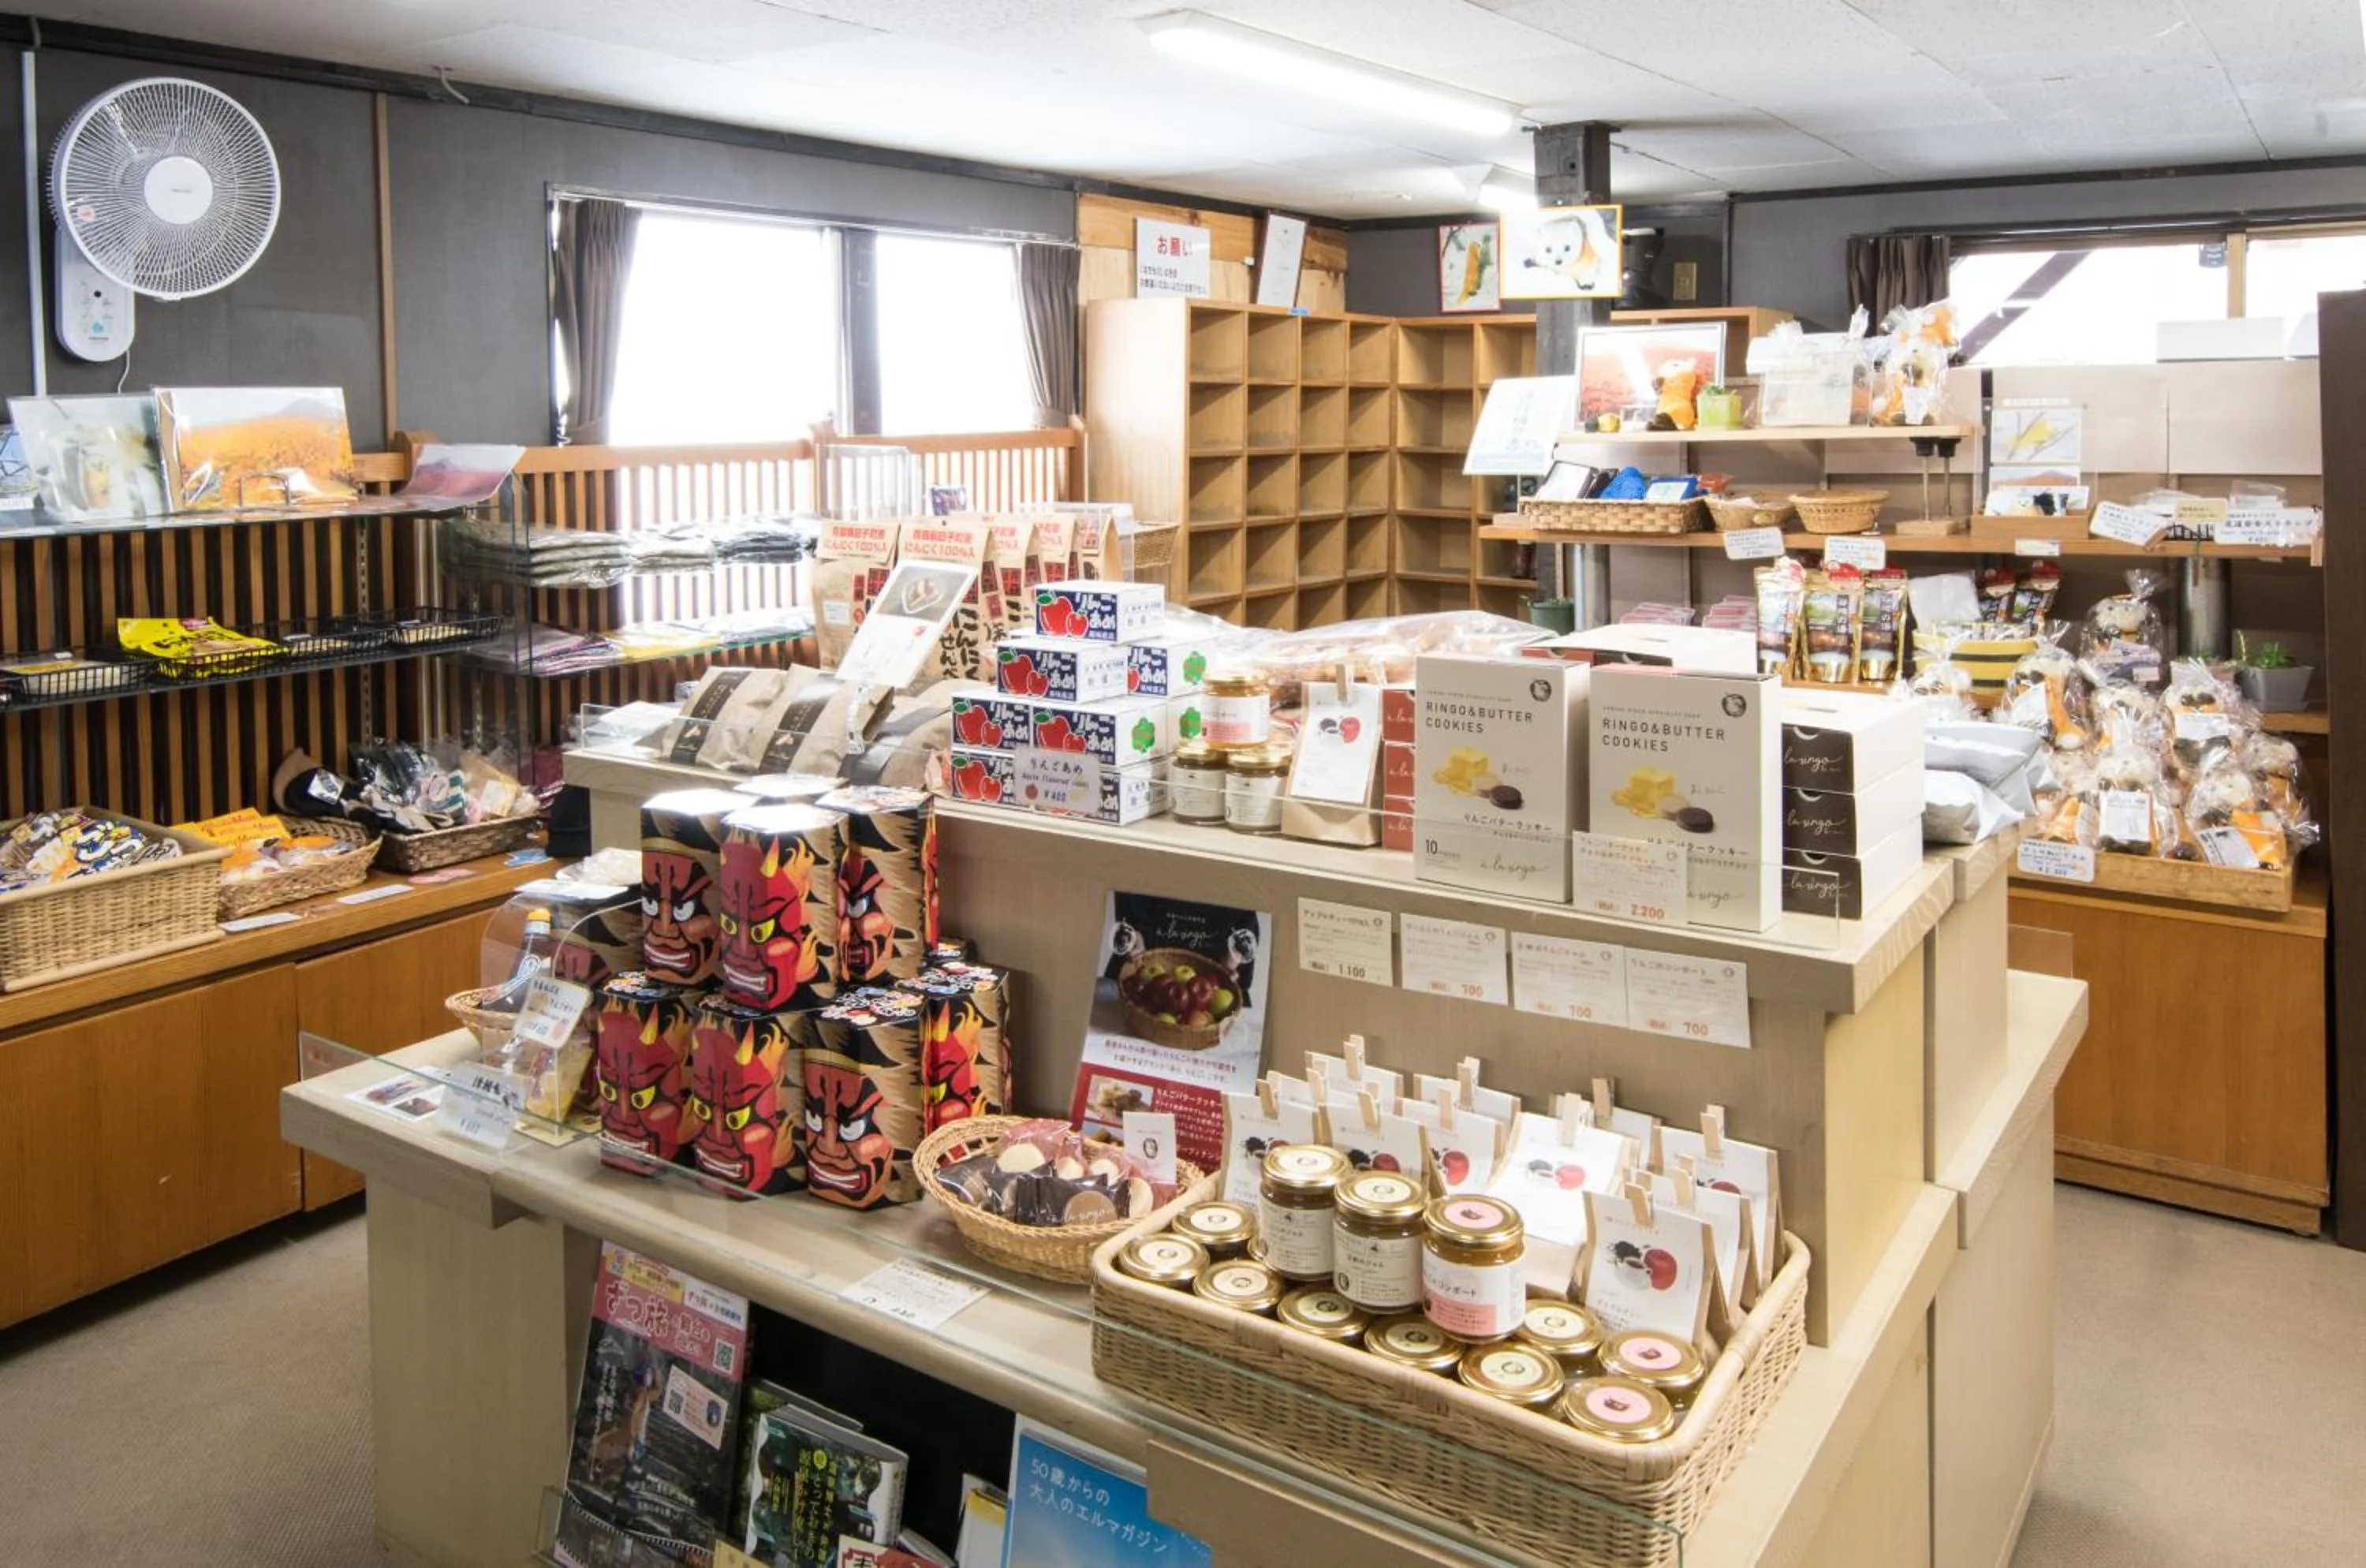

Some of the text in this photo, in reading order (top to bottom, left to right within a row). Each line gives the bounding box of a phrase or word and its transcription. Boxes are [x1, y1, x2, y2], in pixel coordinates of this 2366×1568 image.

[1156, 234, 1193, 256] お願い
[1425, 700, 1533, 723] RINGO&BUTTER
[1425, 717, 1484, 734] COOKIES
[1602, 716, 1726, 741] RINGO&BUTTER
[1602, 734, 1670, 752] COOKIES
[1028, 758, 1084, 775] りんごあめ
[1424, 838, 1438, 855] 10
[1461, 984, 1484, 998] 700
[1567, 1003, 1592, 1019] 700
[1681, 1021, 1709, 1036] 700
[1030, 1458, 1110, 1506] 50歳からの
[1029, 1480, 1167, 1553] 大人のエルマガジン
